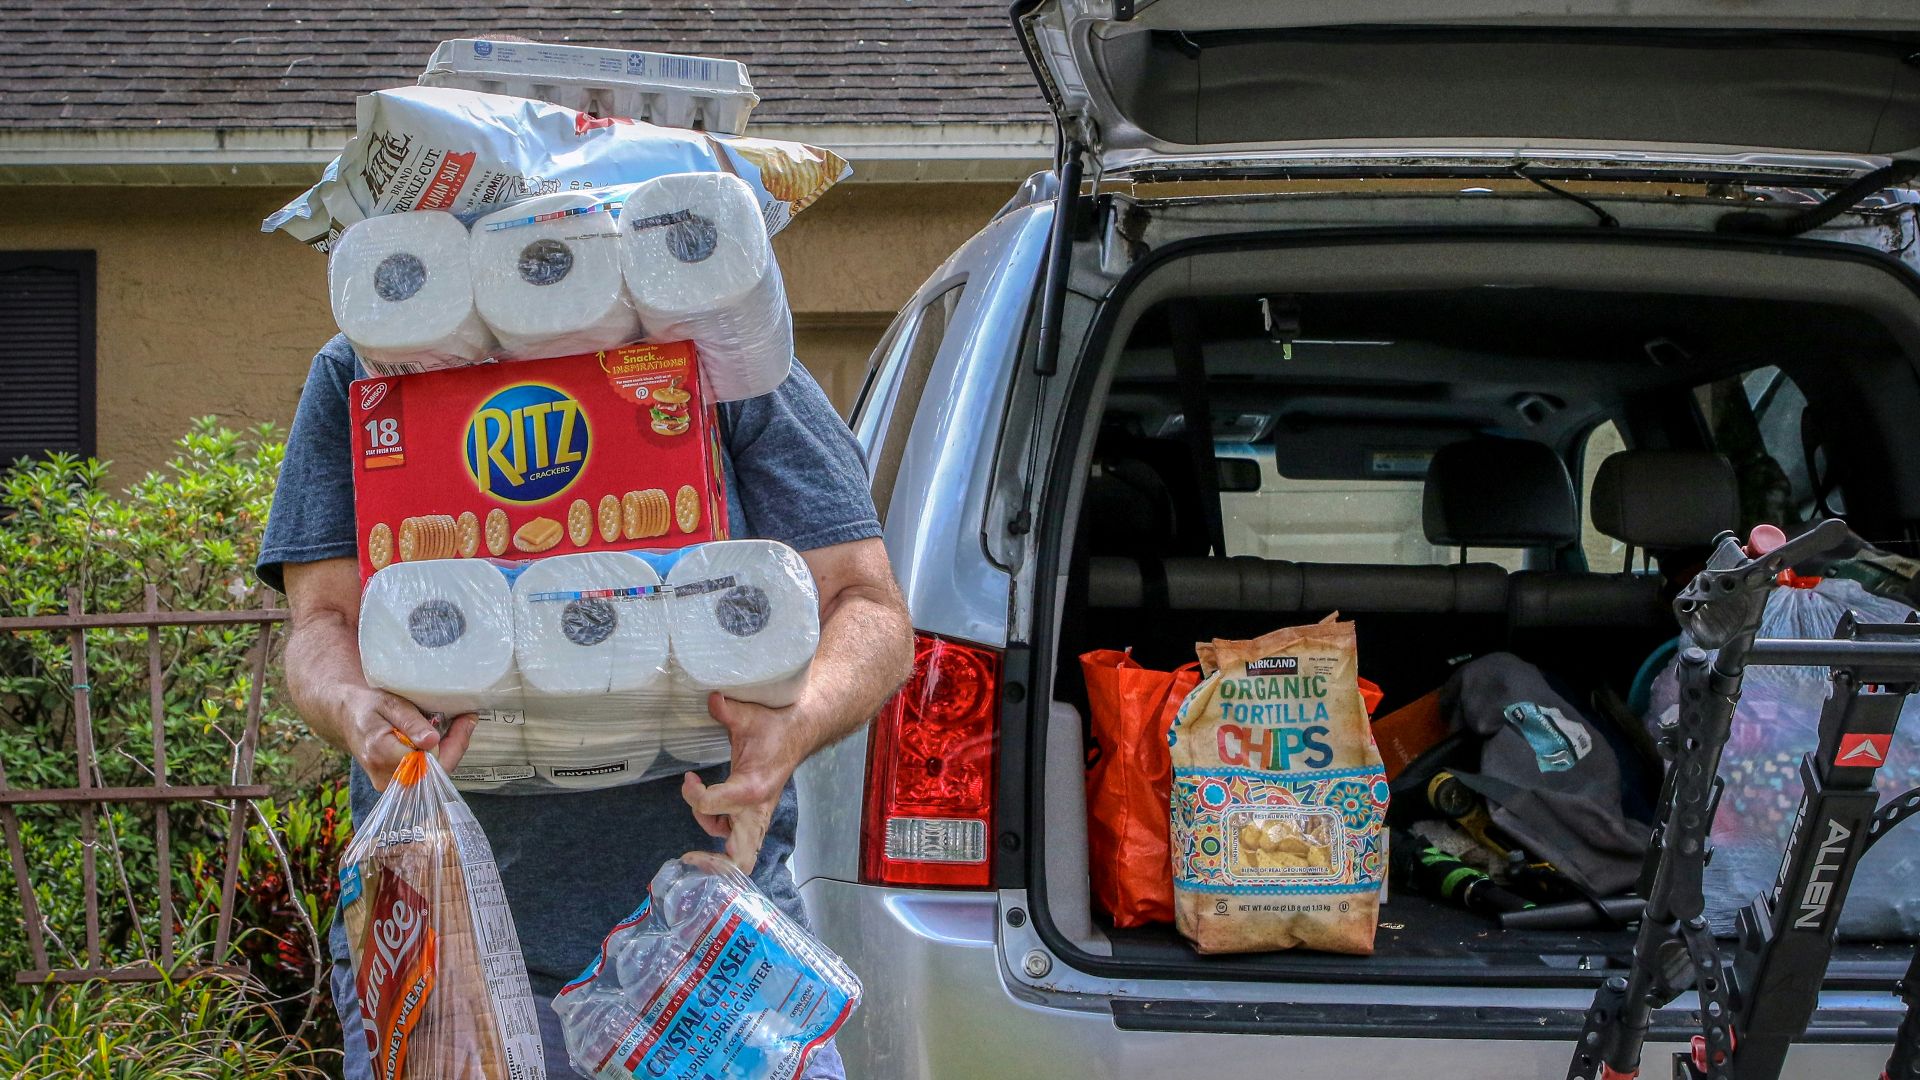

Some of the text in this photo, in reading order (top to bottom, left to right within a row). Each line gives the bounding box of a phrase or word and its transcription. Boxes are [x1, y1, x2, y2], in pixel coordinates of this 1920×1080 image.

[392, 168, 412, 195] BRAND
[442, 160, 460, 181] SALT
[472, 170, 491, 197] PROMISE
[449, 173, 465, 197] CHIPS
[482, 172, 505, 204] PROMISE
[613, 357, 686, 375] INSPIRATIONS!
[623, 352, 656, 364] Snack
[363, 384, 385, 408] NABISCO
[365, 418, 400, 448] 18
[389, 446, 403, 454] PACKS
[473, 400, 582, 493] RITZ
[529, 465, 571, 481] CRACKERS
[1248, 658, 1296, 670] KIRKLAND
[1220, 675, 1328, 700] ORGANIC
[1220, 702, 1329, 724] TORTILLA
[1217, 724, 1333, 771] CHIPS
[557, 765, 622, 777] KIRKLAND
[1794, 819, 1851, 929] ALLEN
[1323, 904, 1331, 912] kg
[359, 900, 422, 1060] Sara Lee
[644, 1009, 673, 1047] BOTTLED
[673, 994, 684, 1008] AT
[684, 973, 699, 992] THE
[700, 938, 724, 975] SOURCE
[645, 1006, 707, 1078] CRYSTAL
[697, 934, 757, 1008] GEYSER
[709, 1000, 746, 1047] SPRING
[740, 959, 773, 1003] WATER
[788, 1001, 803, 1018] CRYSTAL
[386, 976, 426, 1080] HONEY WHEAT
[687, 982, 745, 1056] NATURAL
[735, 1014, 754, 1037] ROXANE
[507, 1047, 518, 1080] trition
